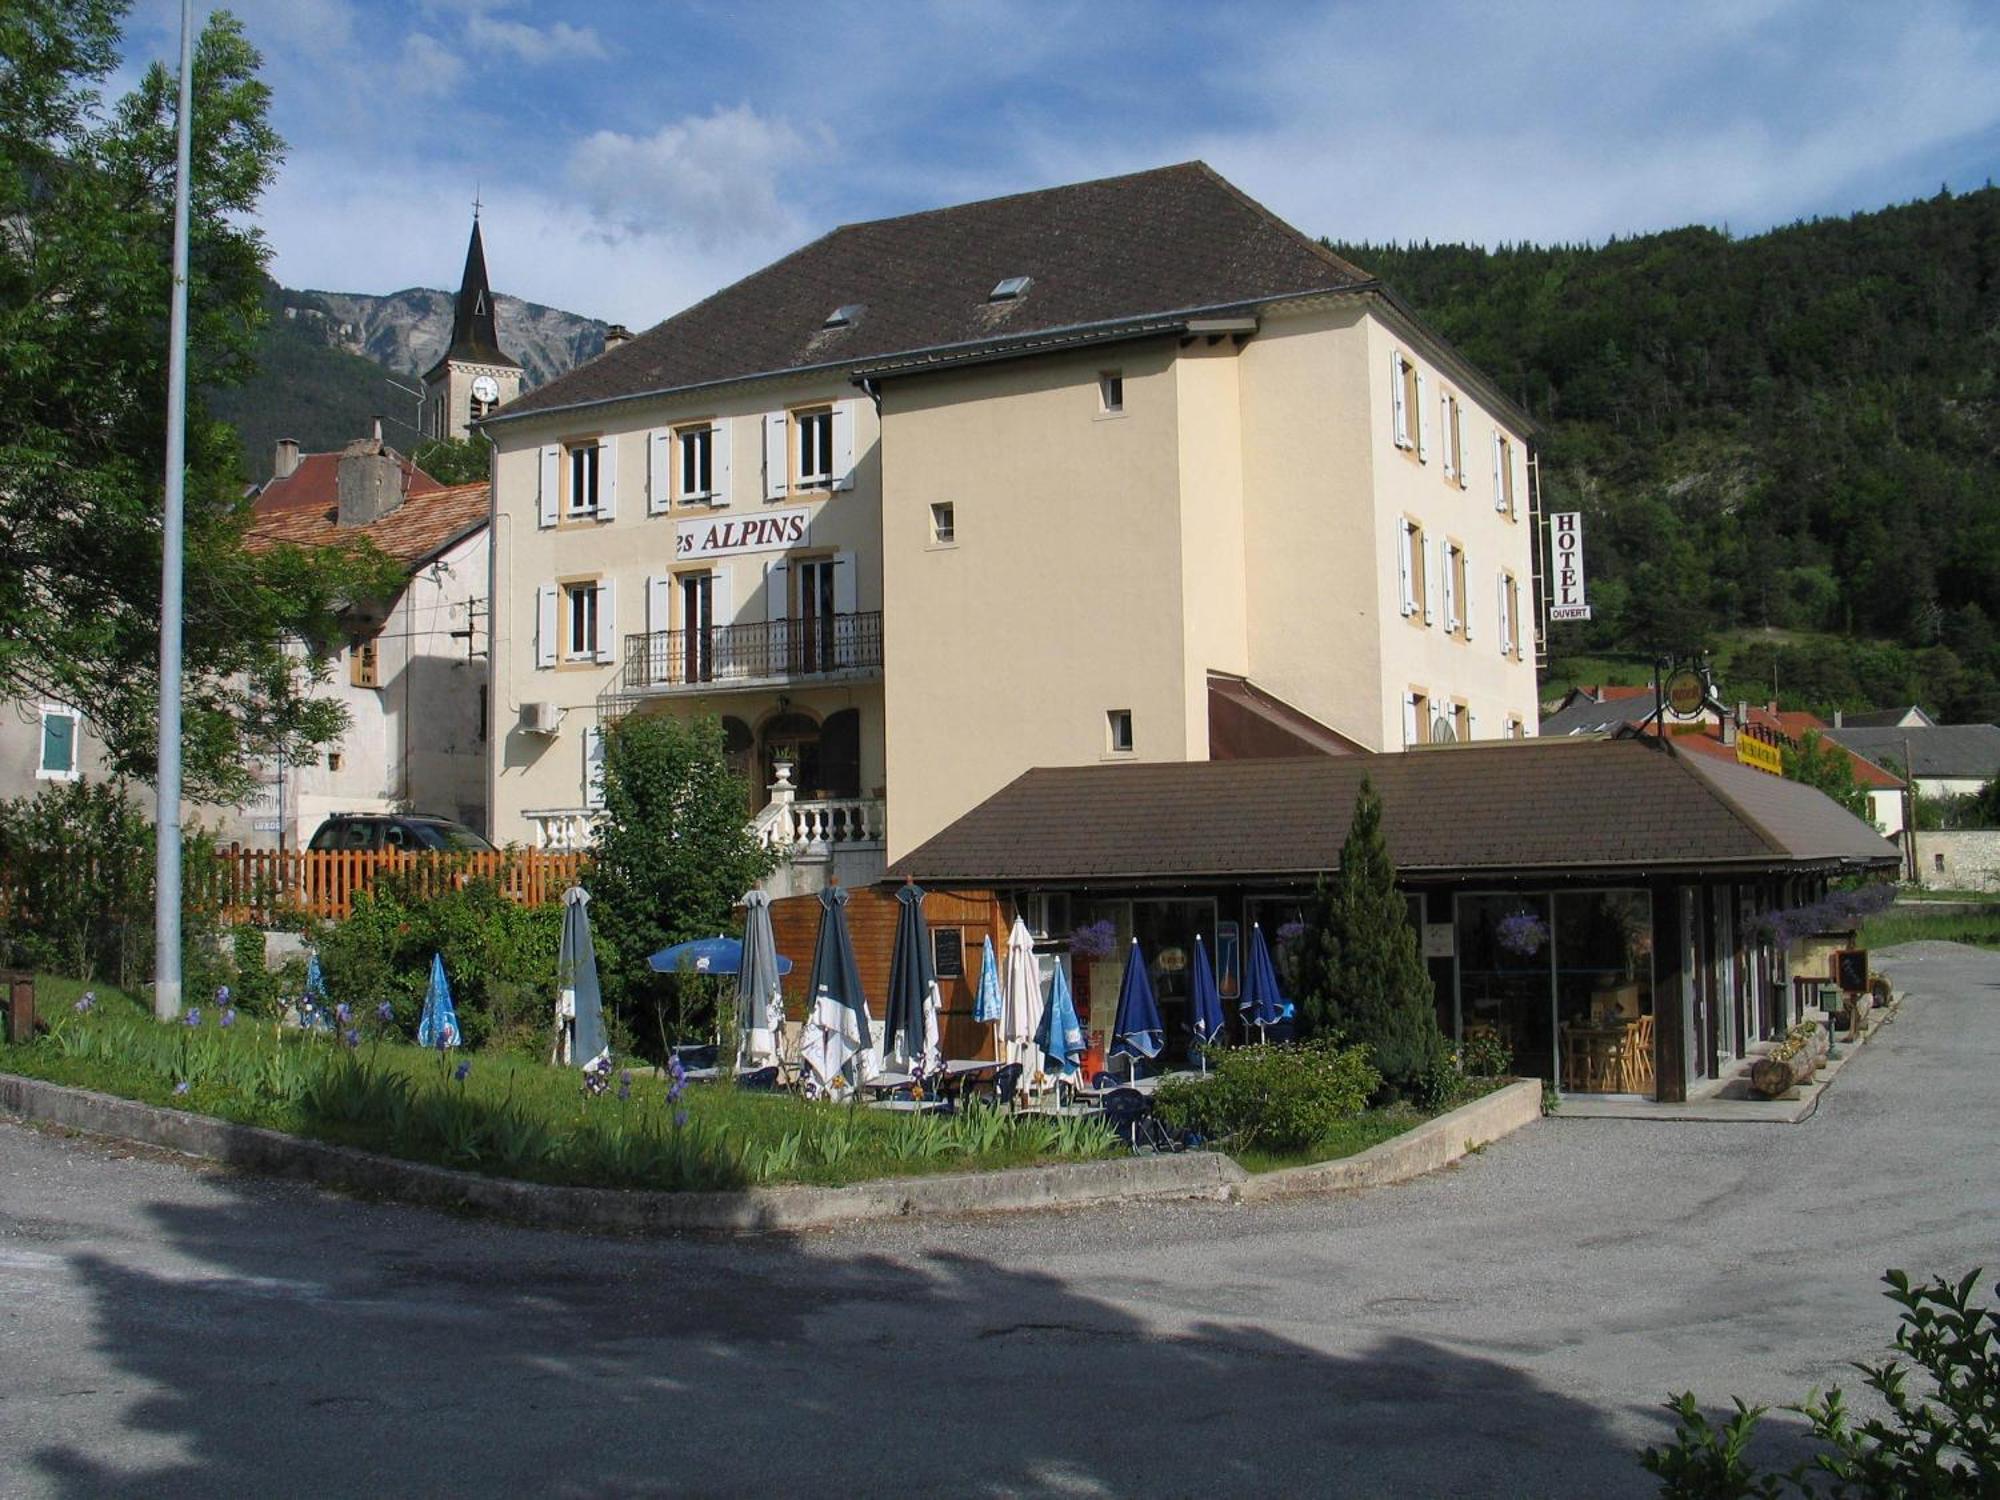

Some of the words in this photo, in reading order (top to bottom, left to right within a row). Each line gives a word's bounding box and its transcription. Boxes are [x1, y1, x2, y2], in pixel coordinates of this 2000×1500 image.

[702, 515, 804, 550] ALPINS
[1556, 514, 1577, 605] HOTEL
[1552, 607, 1587, 619] OUVERT
